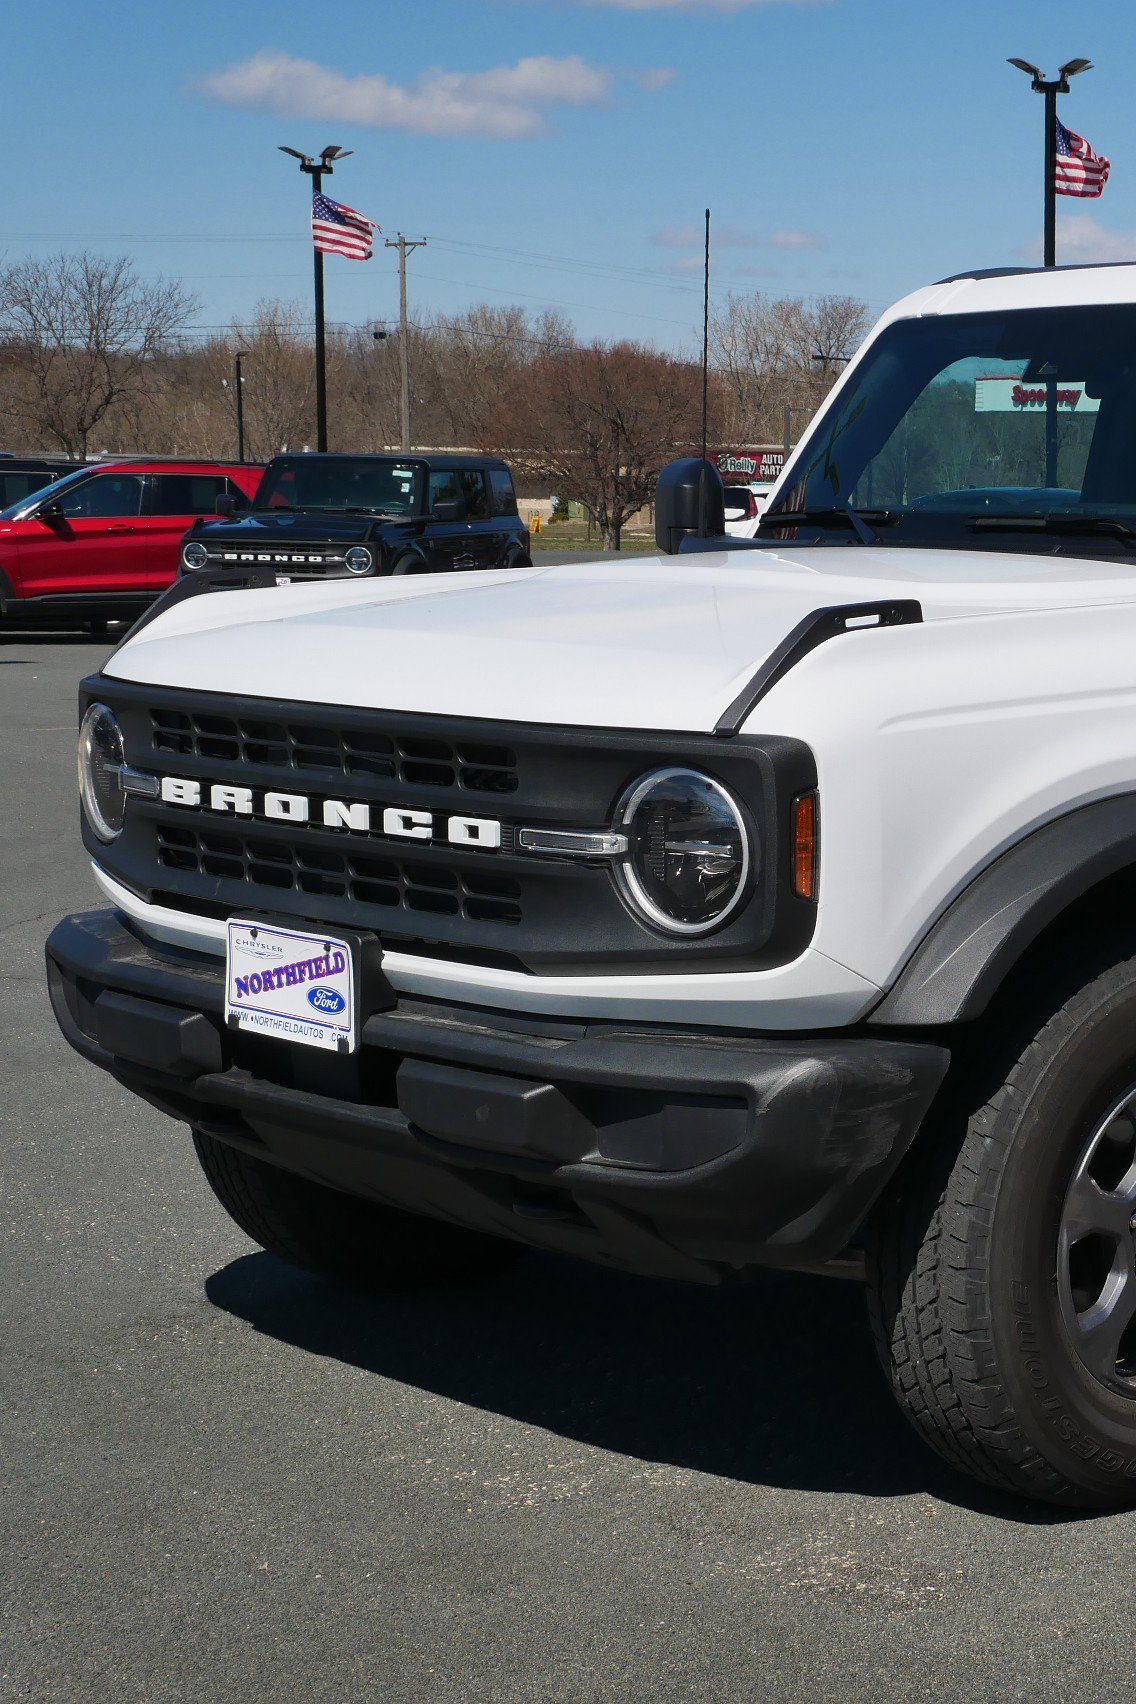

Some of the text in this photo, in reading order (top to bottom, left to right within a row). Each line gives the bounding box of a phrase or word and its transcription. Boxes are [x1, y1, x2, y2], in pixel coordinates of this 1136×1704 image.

[761, 455, 783, 464] AUTO
[224, 553, 323, 562] BRONCO
[161, 777, 501, 848] BRONCO
[235, 938, 284, 953] CHRYSLER
[234, 951, 346, 999] NORTHFIELD
[313, 988, 339, 1010] Ford
